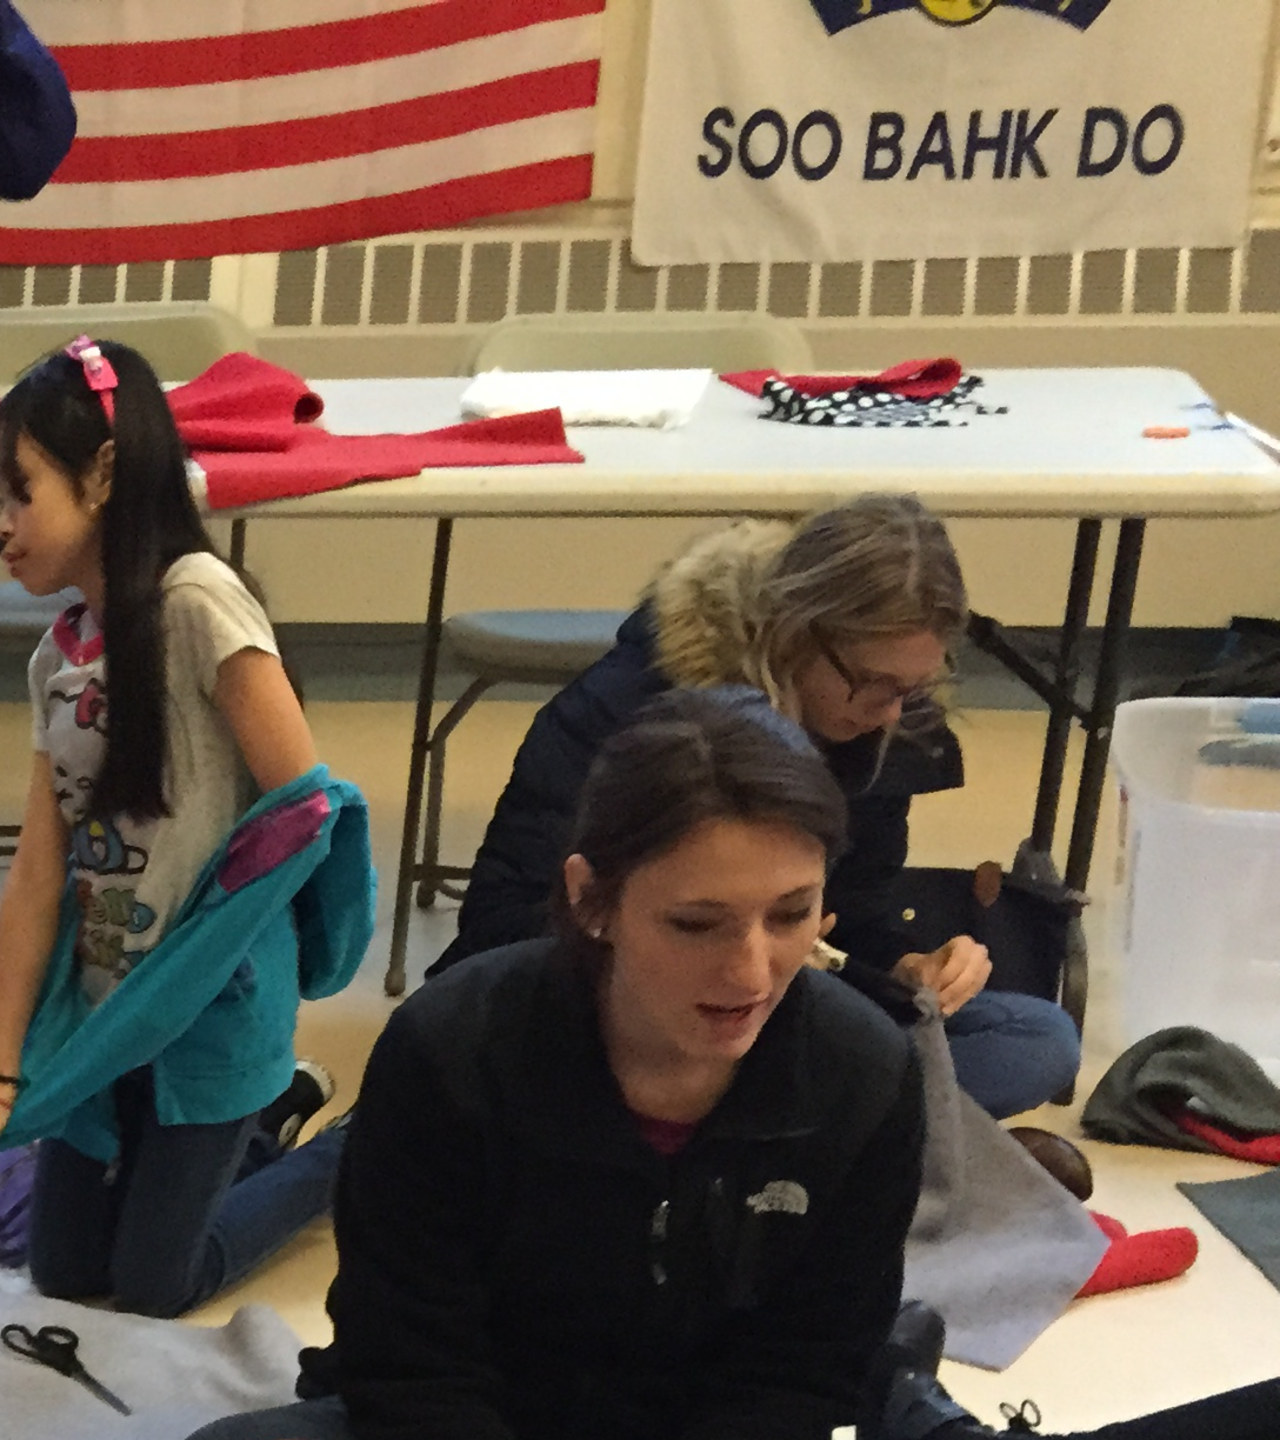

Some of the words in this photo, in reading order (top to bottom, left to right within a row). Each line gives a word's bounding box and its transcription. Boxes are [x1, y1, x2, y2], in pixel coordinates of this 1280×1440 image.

[697, 106, 843, 182] SOO
[862, 108, 1059, 181] BAHK
[1076, 103, 1185, 178] DO
